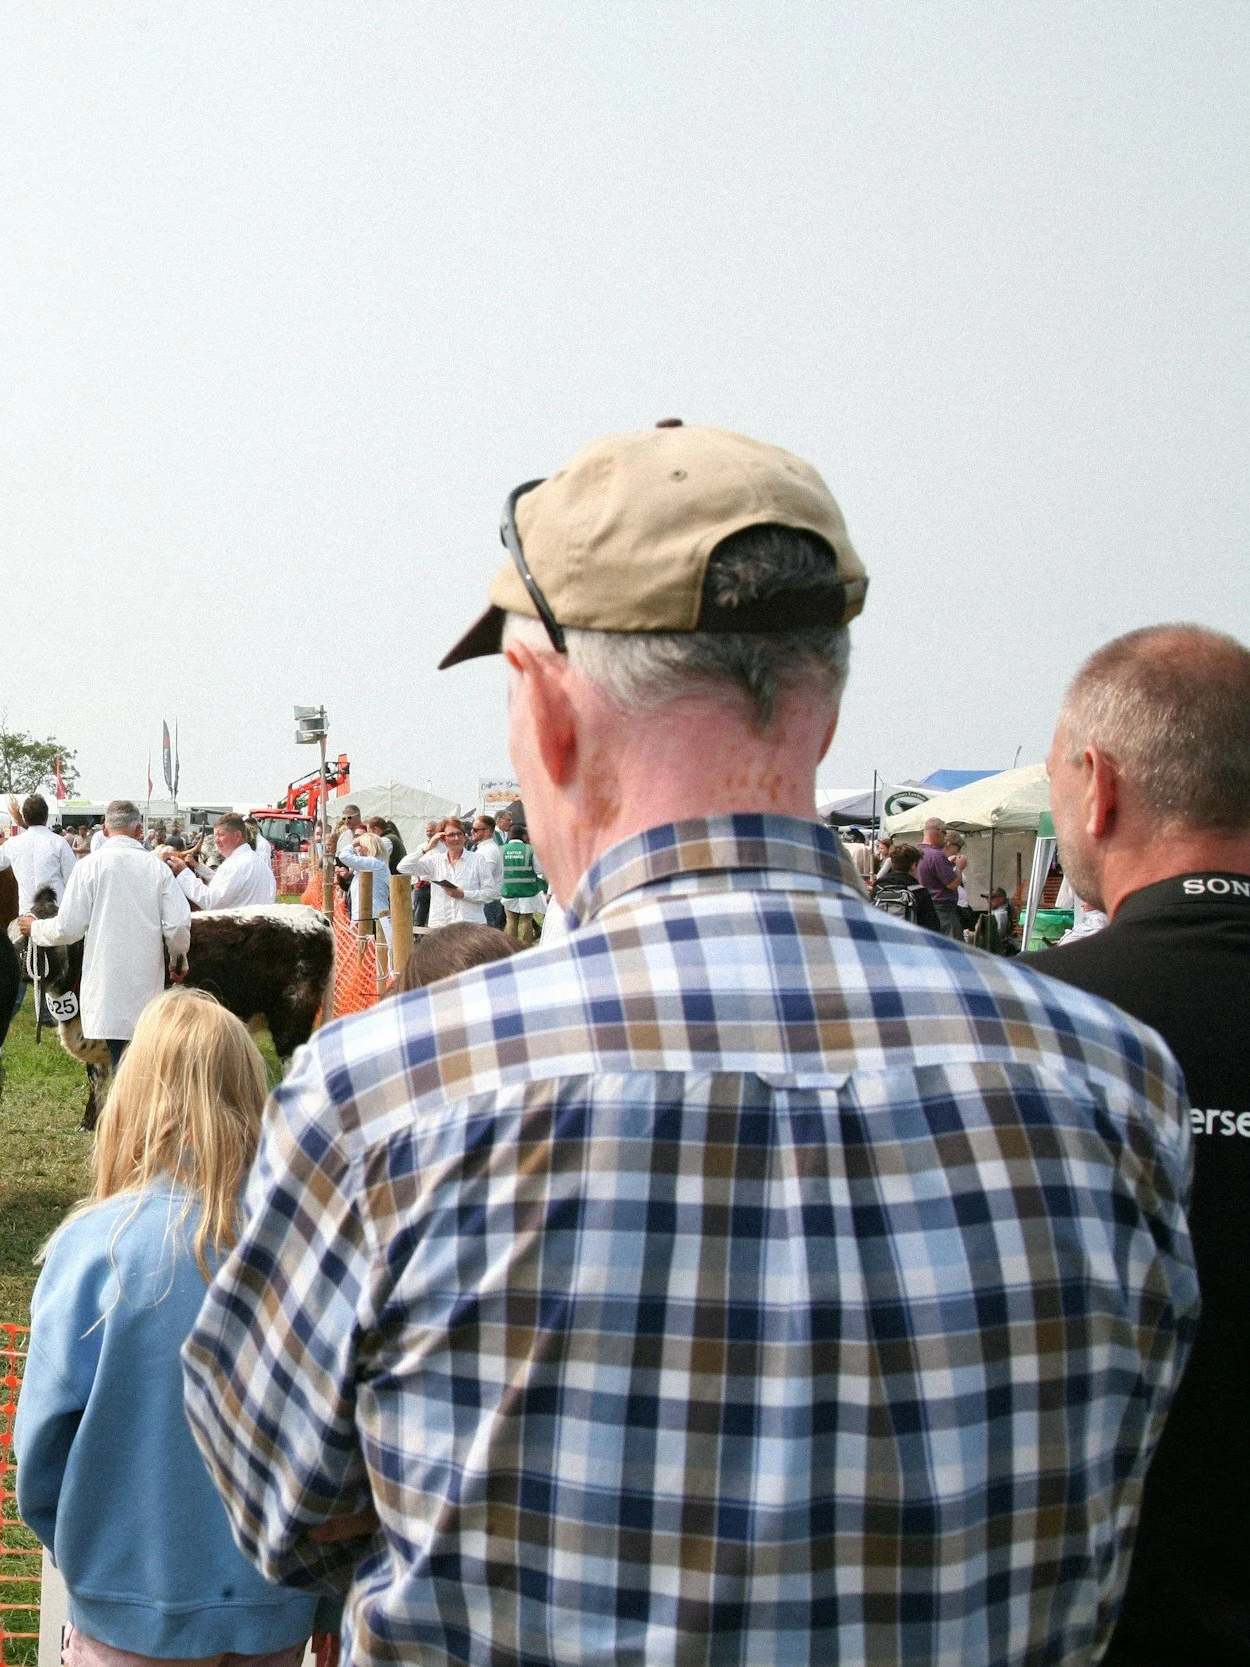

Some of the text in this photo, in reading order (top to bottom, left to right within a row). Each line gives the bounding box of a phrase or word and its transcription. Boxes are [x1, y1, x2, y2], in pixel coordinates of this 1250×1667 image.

[481, 781, 497, 790] Coffee
[1183, 878, 1250, 897] SON
[47, 998, 75, 1014] 625
[1190, 1108, 1250, 1138] erse
